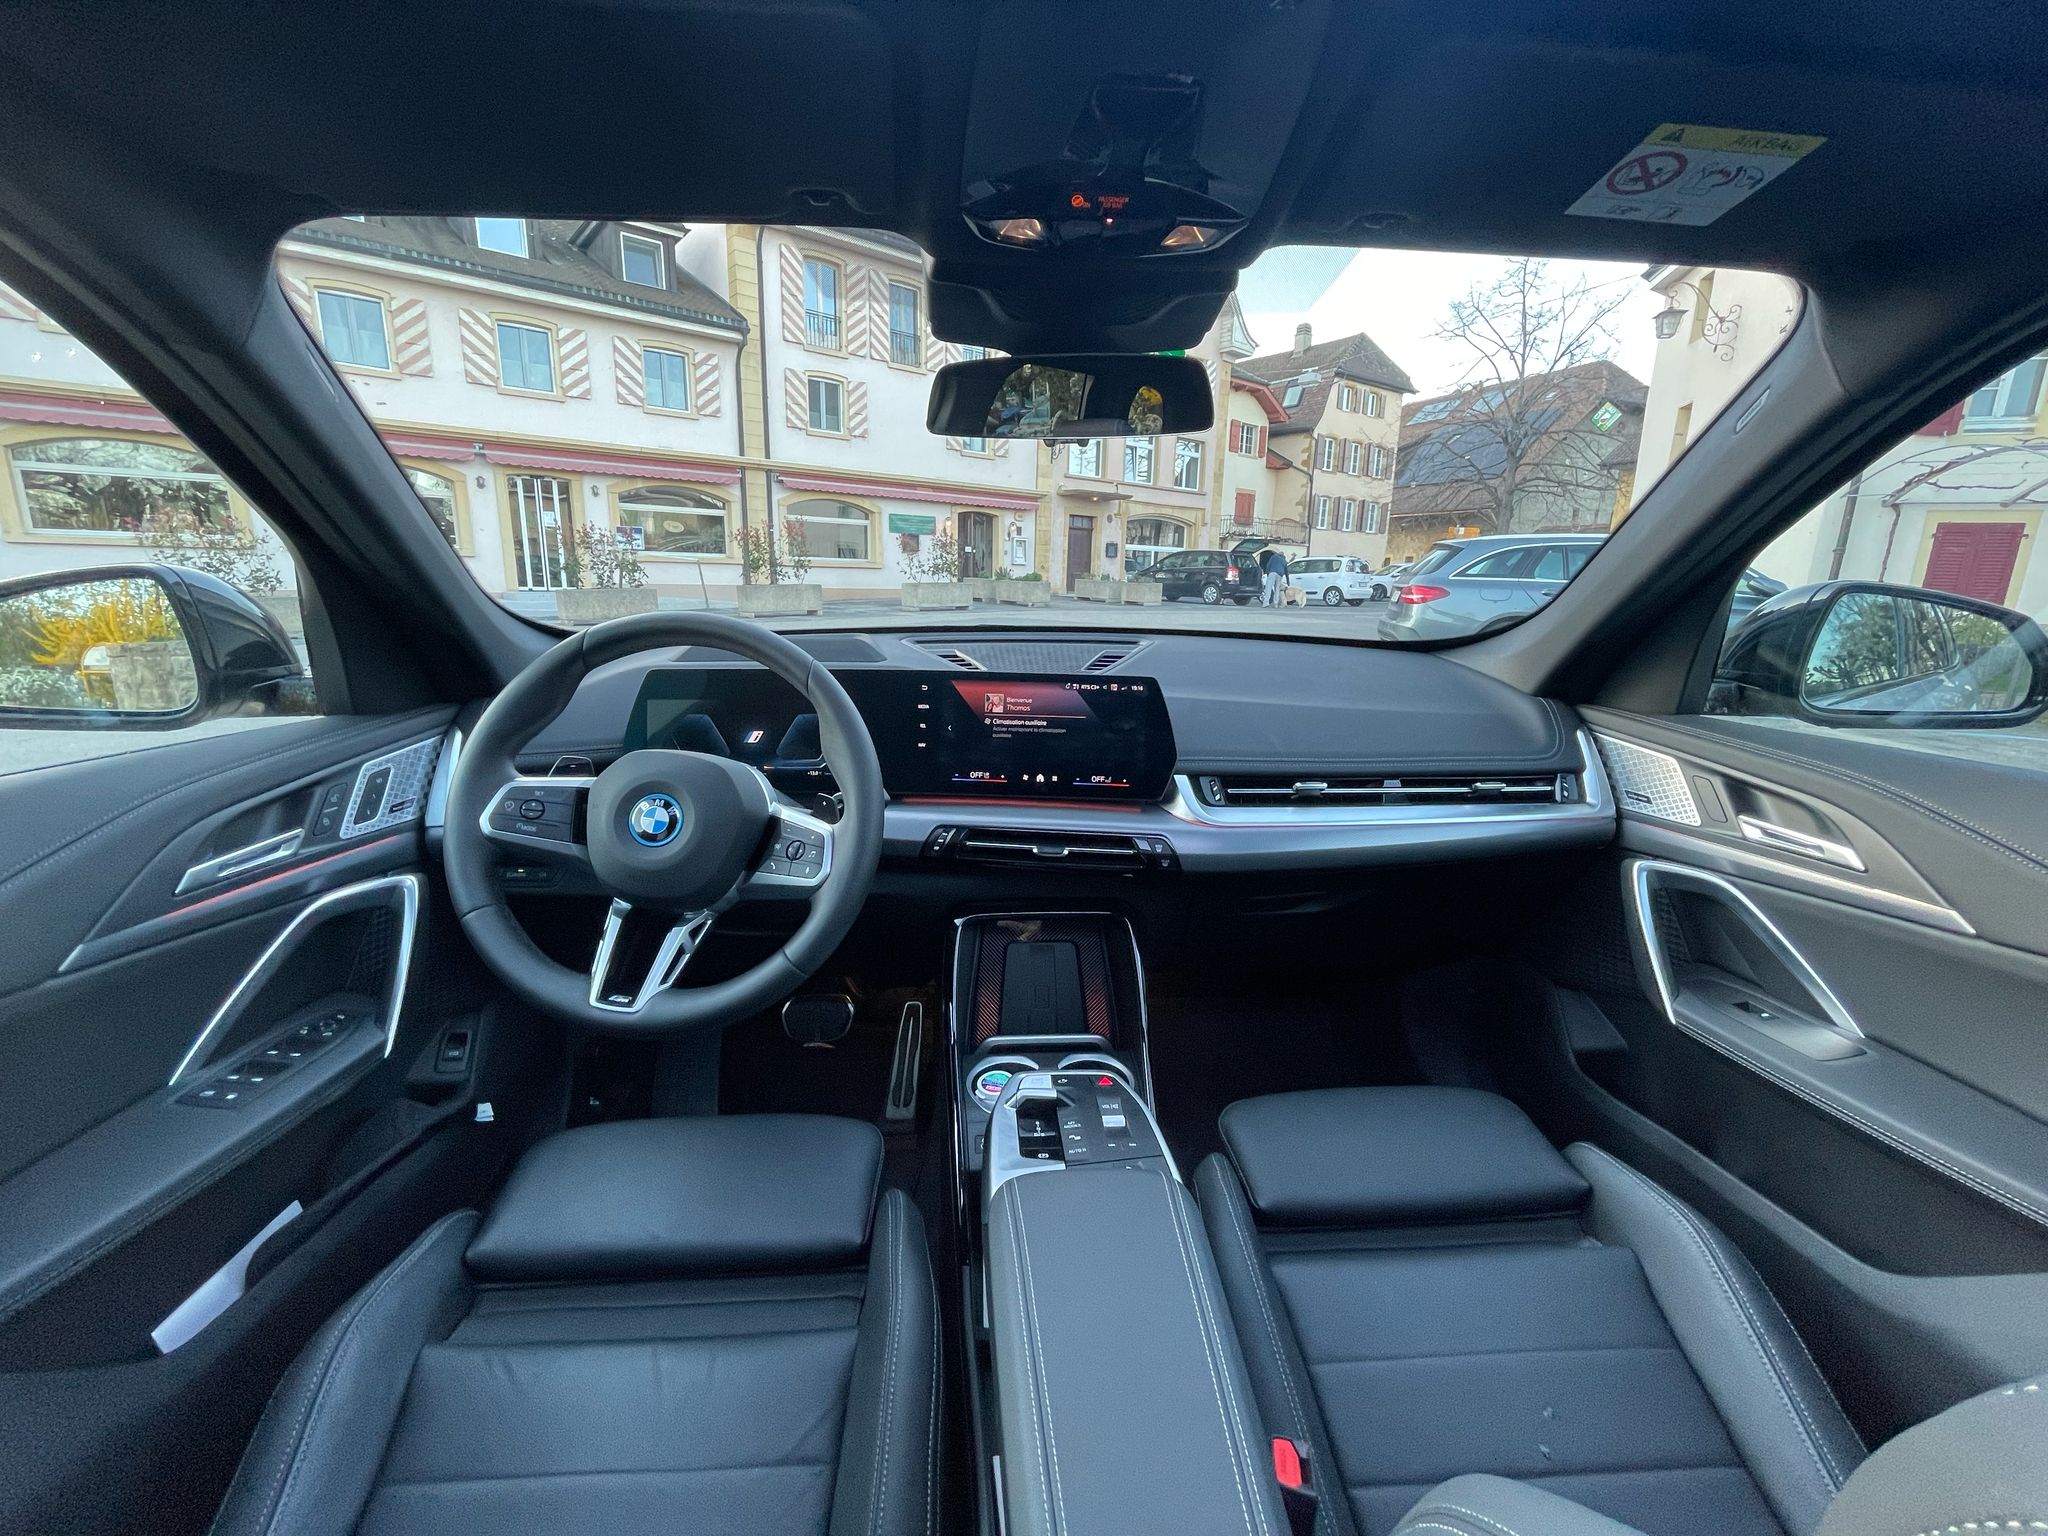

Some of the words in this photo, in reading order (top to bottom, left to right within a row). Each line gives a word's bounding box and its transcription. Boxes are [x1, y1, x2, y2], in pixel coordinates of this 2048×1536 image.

[969, 771, 984, 779] OFF
[1091, 775, 1105, 783] OFF
[641, 799, 677, 816] BMW
